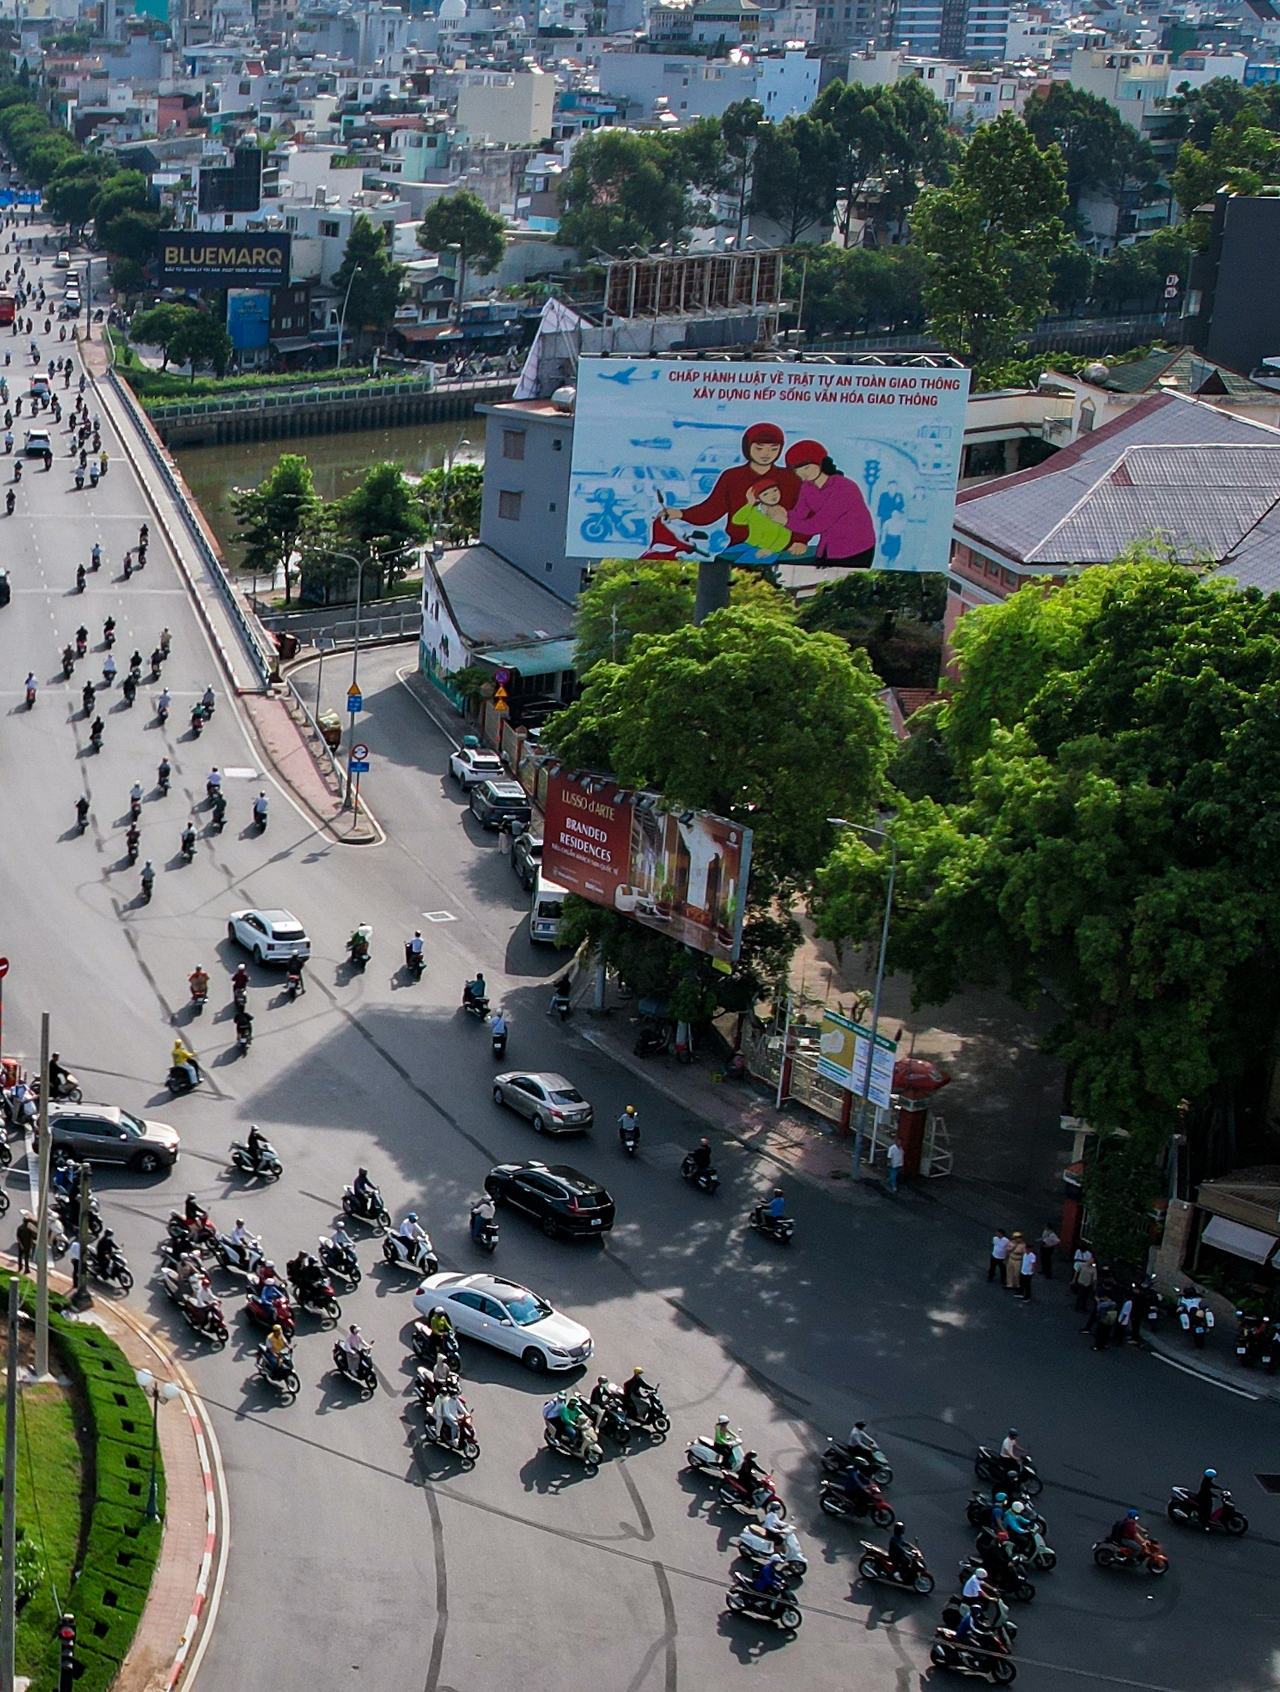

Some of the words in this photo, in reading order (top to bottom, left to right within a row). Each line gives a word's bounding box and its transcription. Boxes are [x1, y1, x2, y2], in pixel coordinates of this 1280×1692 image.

[165, 246, 282, 265] BLUEMARQ
[668, 368, 700, 383] CHẤP
[703, 369, 736, 384] HÀNH
[738, 370, 767, 386] LUẬT
[769, 369, 784, 385] VỀ
[787, 371, 816, 387] TRẬT
[818, 374, 835, 388] TỰ
[836, 375, 853, 388] AN
[855, 373, 887, 389] TOÀN
[889, 377, 917, 390] GIAO
[920, 376, 961, 391] THÔNG
[693, 386, 716, 399] XÂY
[717, 388, 751, 402] DỰNG
[753, 386, 777, 401] NẾP
[779, 387, 812, 402] SỐNG
[839, 390, 865, 404] HÓA
[867, 393, 895, 405] GIAO
[897, 392, 939, 407] THÔNG
[561, 789, 588, 810] LUSSO
[565, 817, 608, 843] BRANDED
[560, 832, 612, 863] RESIDENCES
